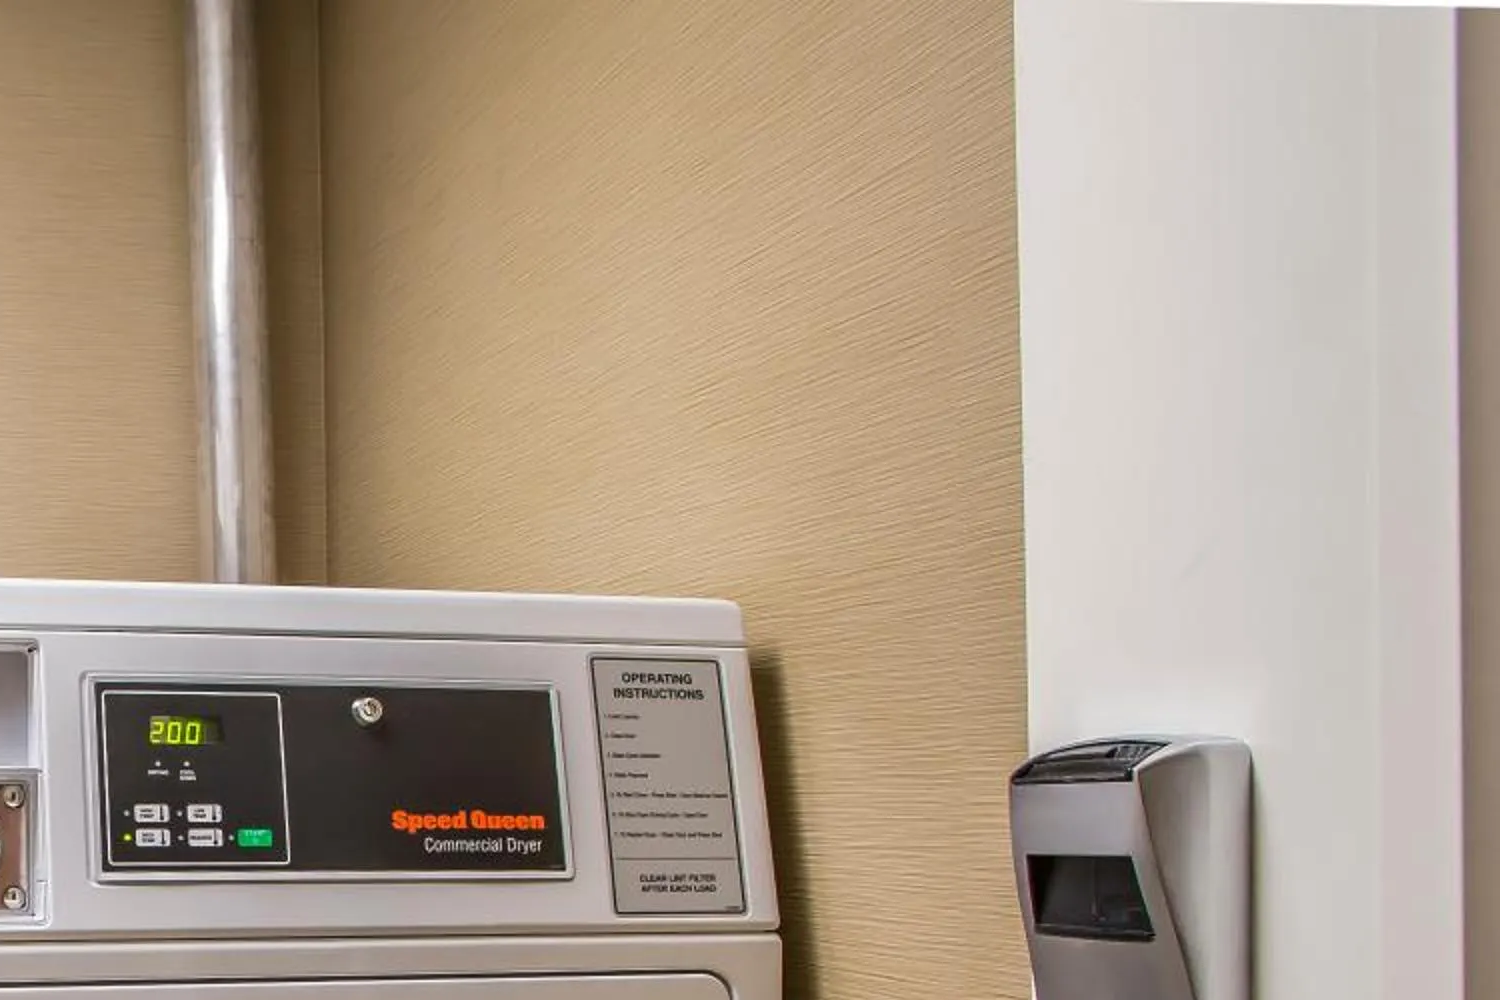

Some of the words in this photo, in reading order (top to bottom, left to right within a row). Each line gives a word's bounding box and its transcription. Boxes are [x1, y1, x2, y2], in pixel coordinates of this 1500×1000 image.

[621, 672, 693, 685] OPERATING
[613, 688, 705, 700] INSTRUCTIONS
[150, 721, 201, 744] 200
[391, 810, 467, 834] Speed
[470, 810, 545, 830] Queen
[424, 837, 502, 853] Commercial
[506, 837, 542, 855] Dryer
